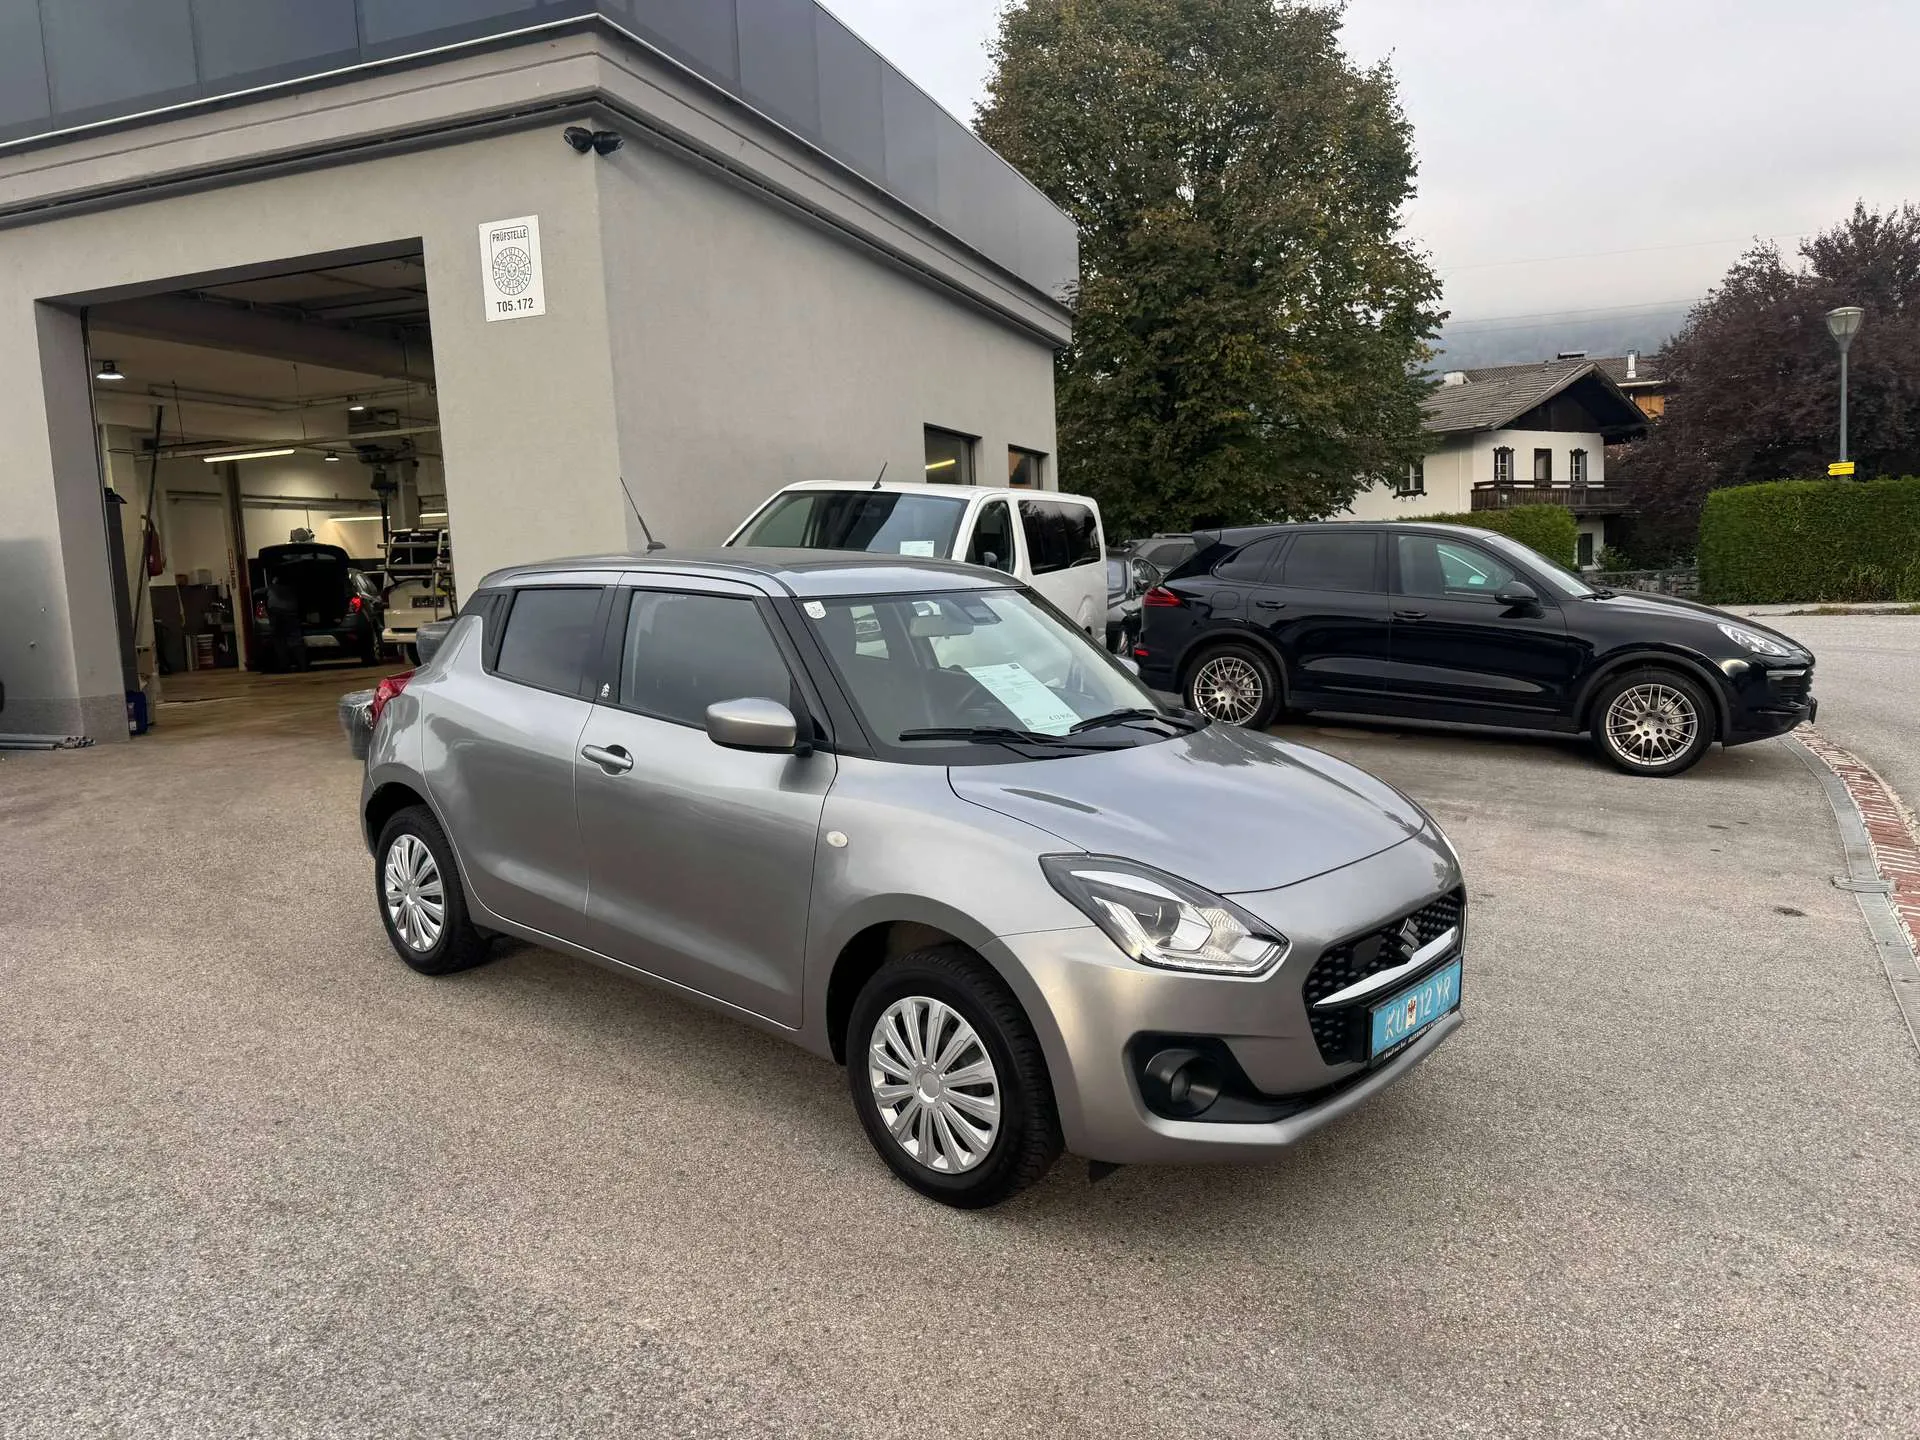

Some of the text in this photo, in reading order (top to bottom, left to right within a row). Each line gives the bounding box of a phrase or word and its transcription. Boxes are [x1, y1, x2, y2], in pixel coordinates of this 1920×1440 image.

[492, 229, 527, 242] PRÜFSTELLE
[496, 298, 534, 312] T05.172
[1385, 1004, 1406, 1040] KU
[1420, 987, 1432, 1018] 12
